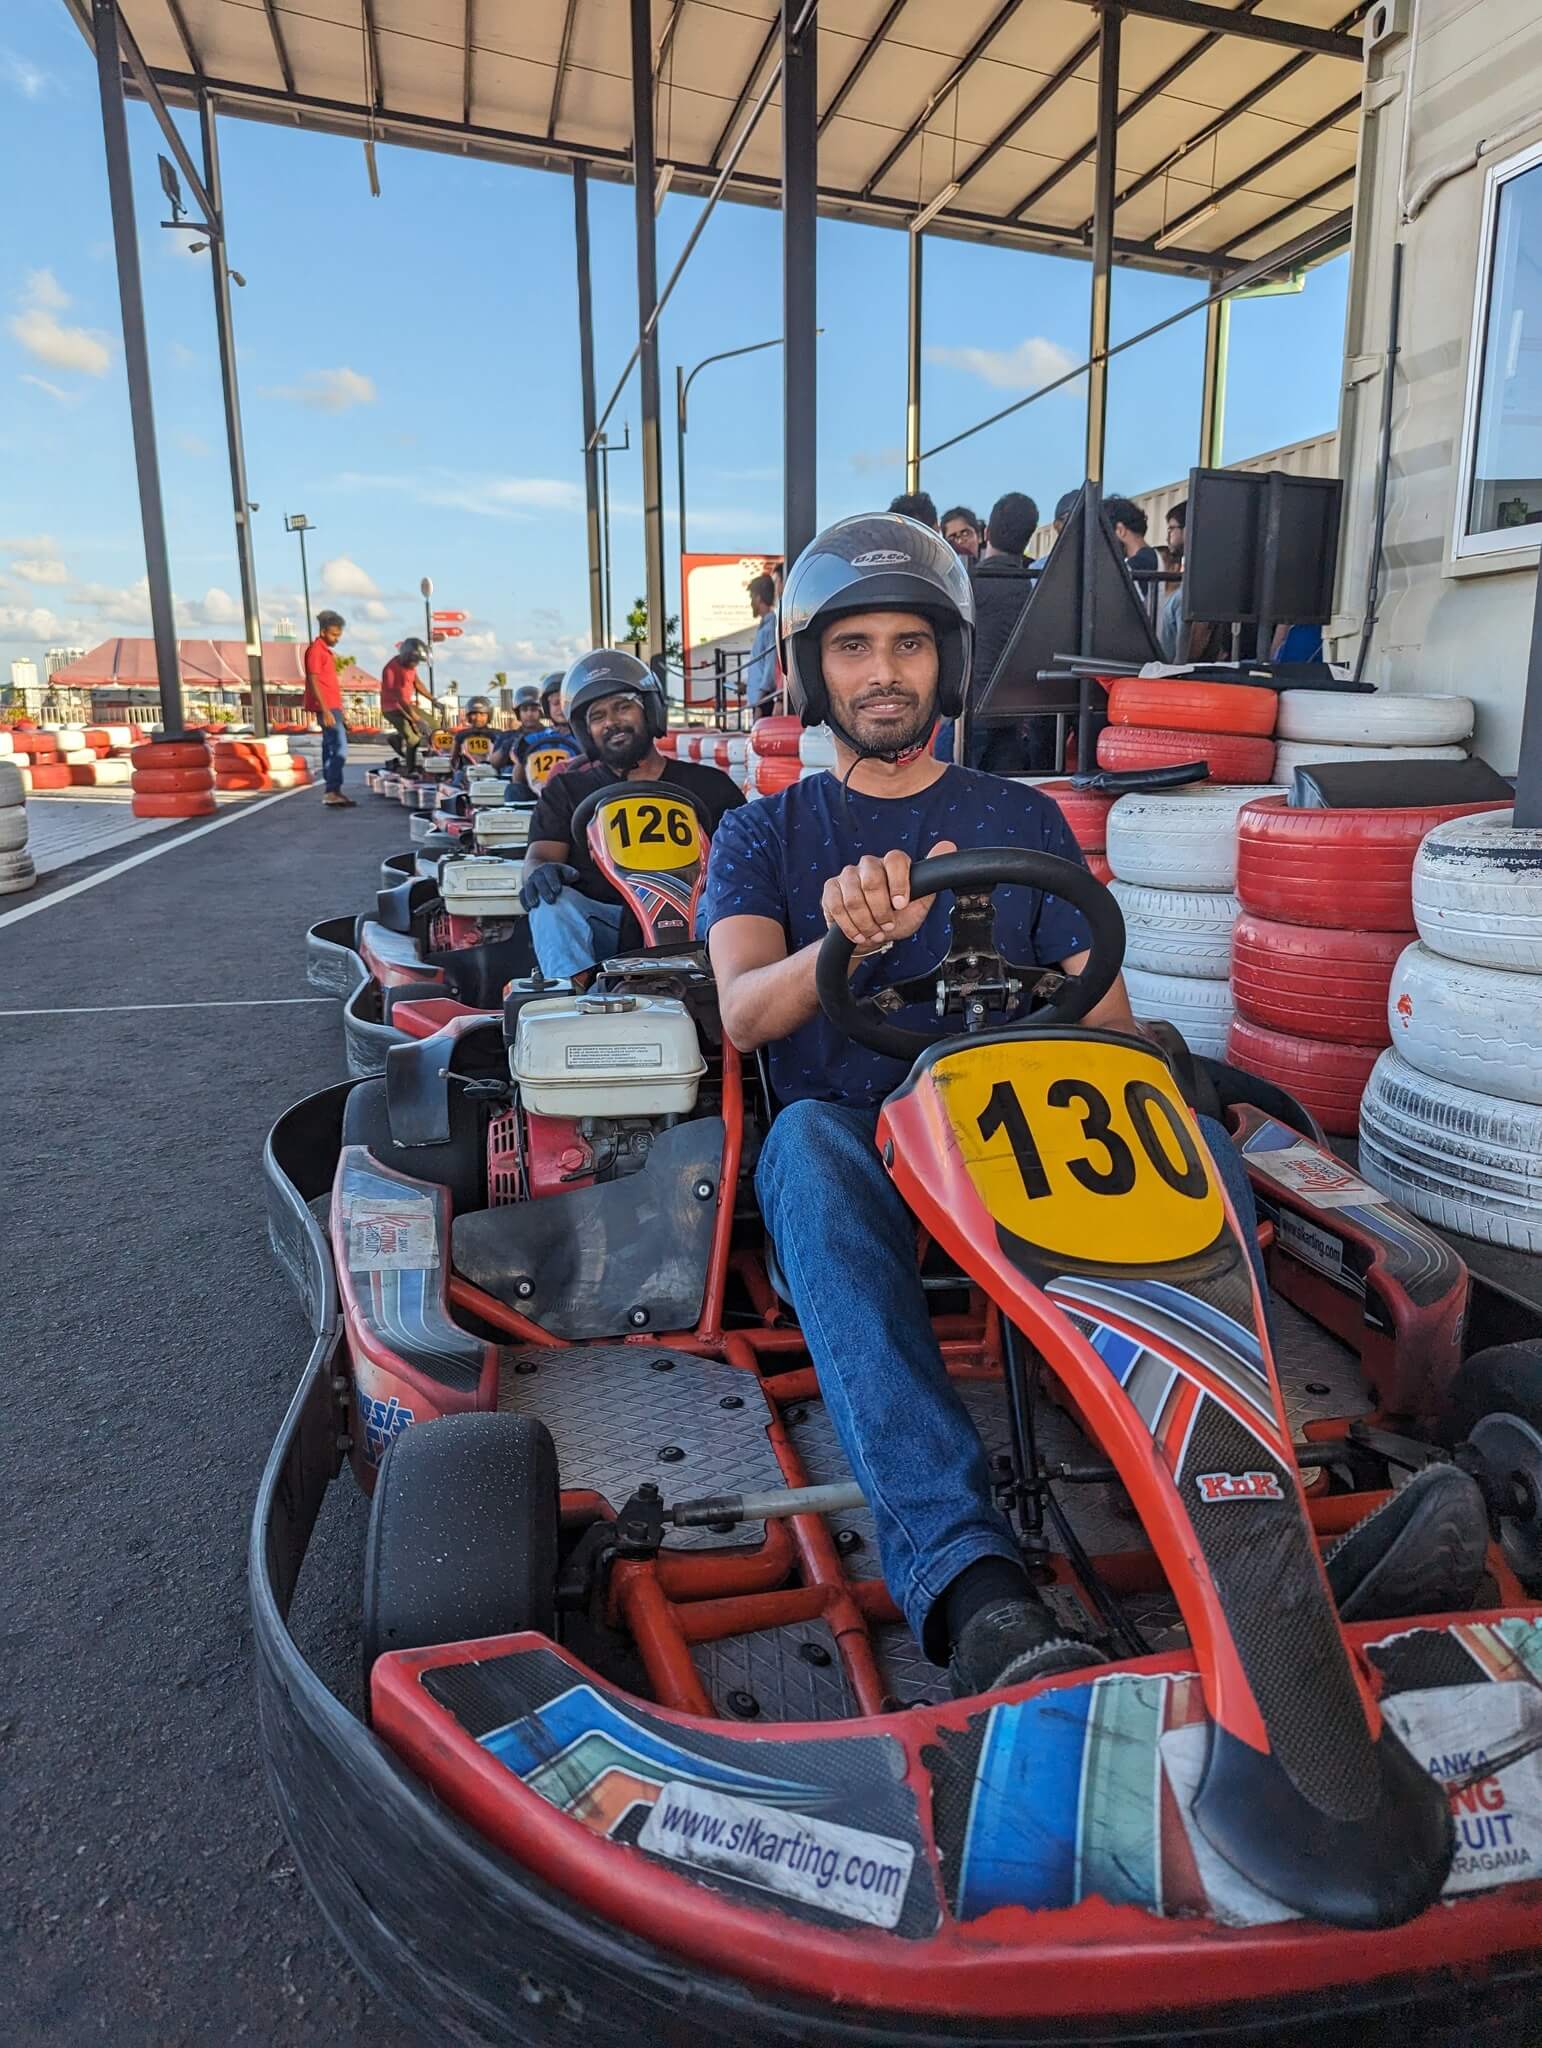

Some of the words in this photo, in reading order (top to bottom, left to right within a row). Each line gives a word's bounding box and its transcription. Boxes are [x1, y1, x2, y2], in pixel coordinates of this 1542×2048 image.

[470, 739, 488, 749] 118
[610, 805, 692, 849] 126
[977, 1079, 1208, 1200] 130
[661, 1803, 900, 1898] www.slkarting.com
[1455, 1814, 1513, 1852] UIT
